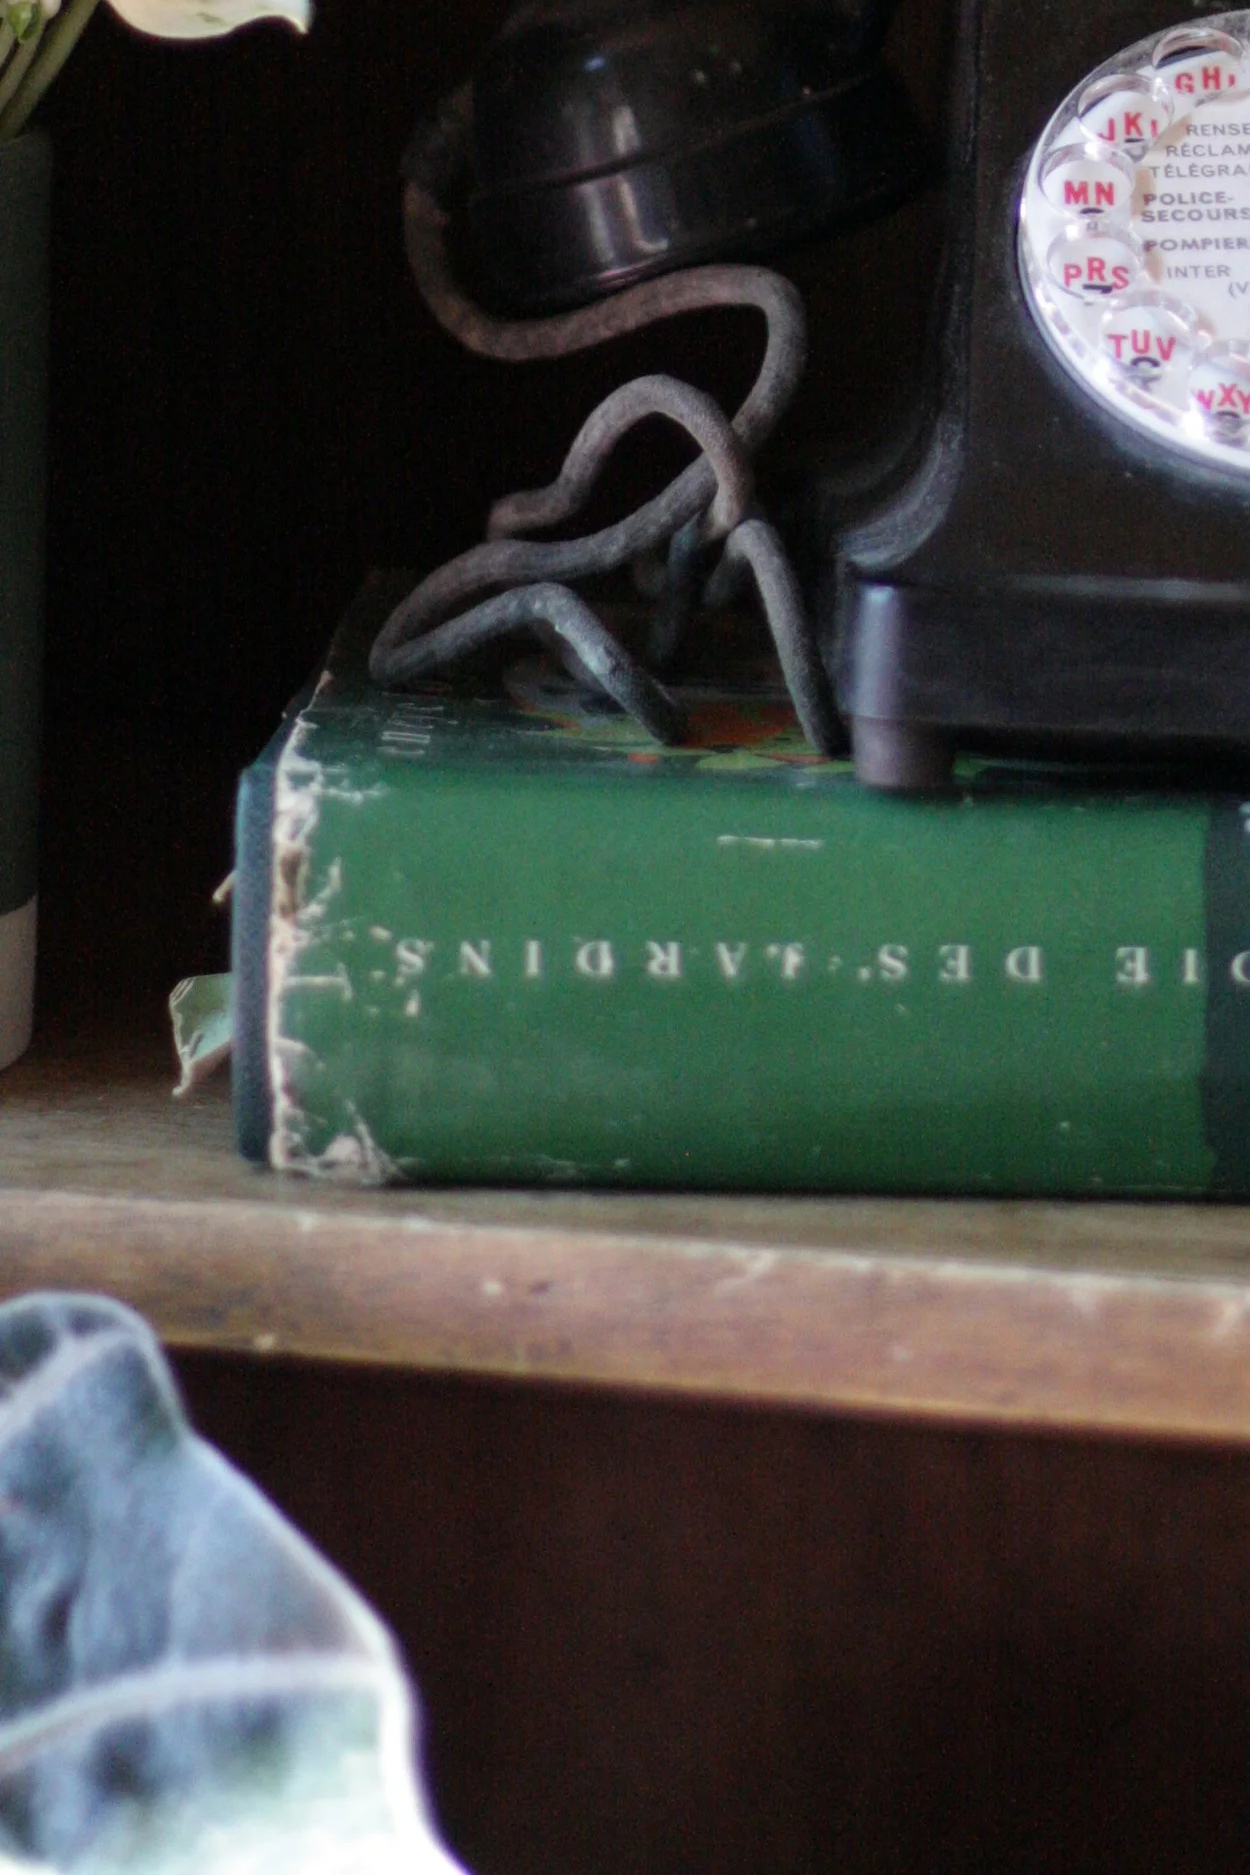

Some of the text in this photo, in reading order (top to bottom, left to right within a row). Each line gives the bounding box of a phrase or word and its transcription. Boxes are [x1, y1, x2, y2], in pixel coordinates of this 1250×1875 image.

[1063, 180, 1115, 207] MN
[1143, 191, 1234, 207] POLICE-
[1063, 256, 1130, 291] PRS
[1166, 264, 1232, 279] INTER
[1108, 329, 1176, 362] TUV
[877, 943, 1044, 985] DES
